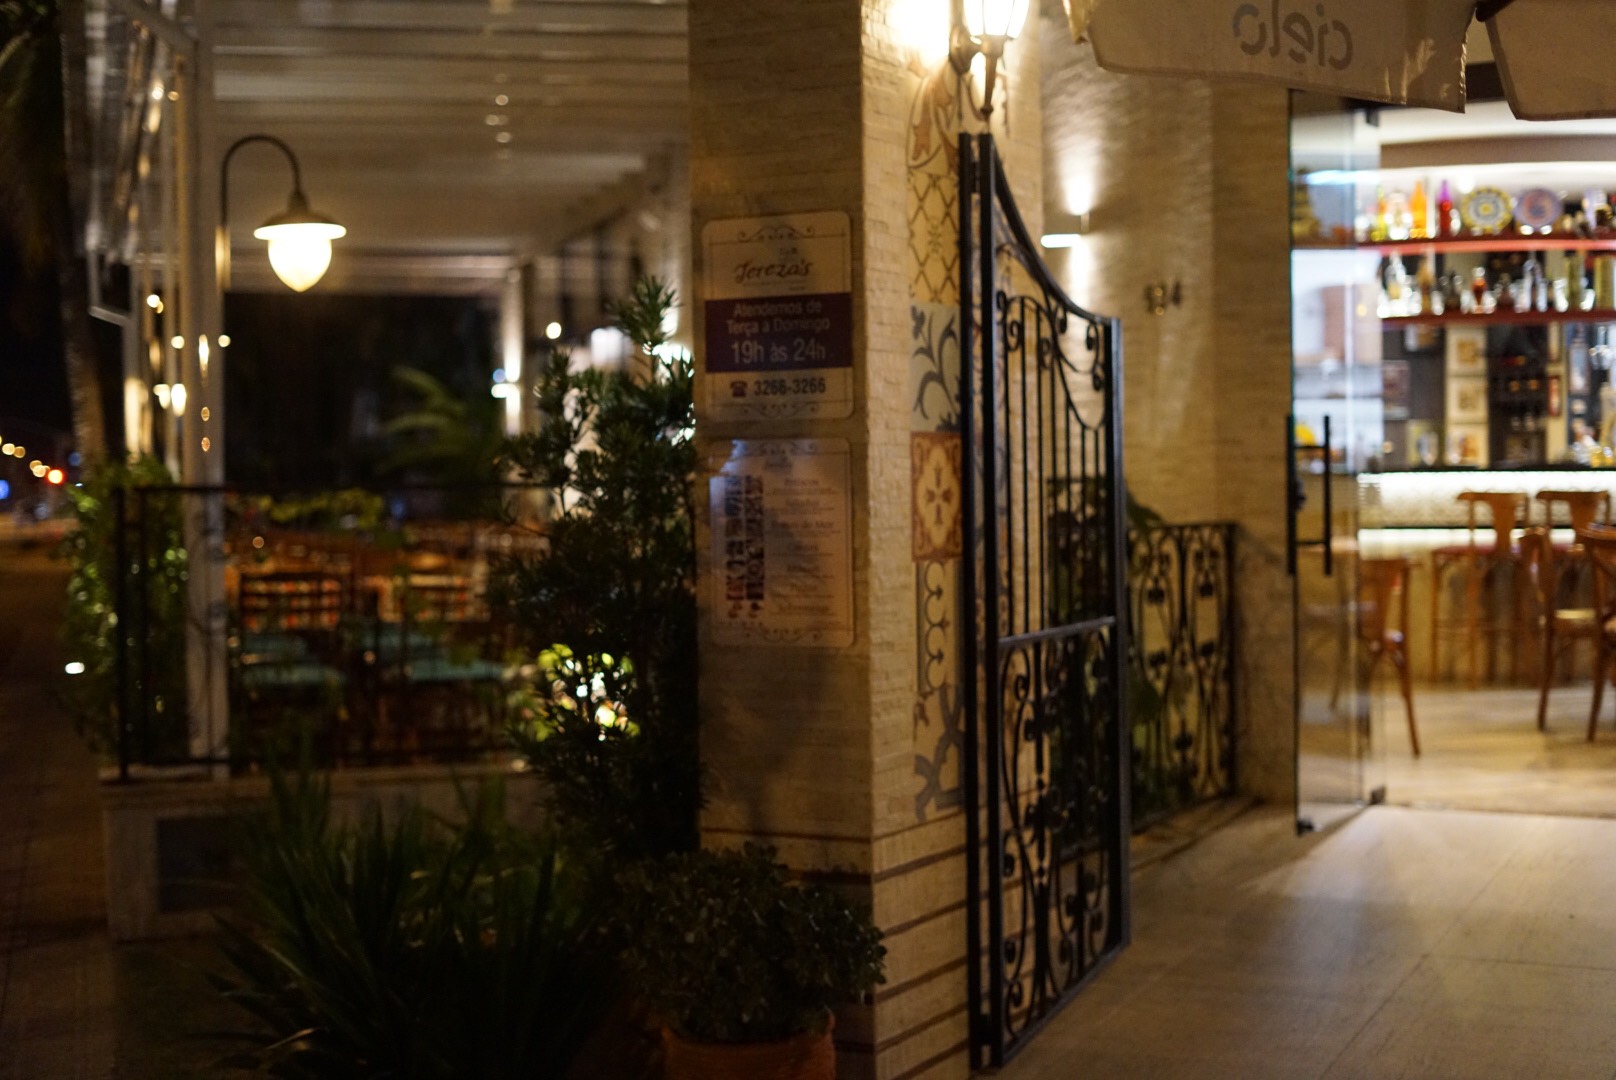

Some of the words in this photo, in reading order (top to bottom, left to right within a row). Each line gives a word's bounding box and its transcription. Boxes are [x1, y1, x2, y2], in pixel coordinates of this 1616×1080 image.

[805, 300, 823, 314] de
[773, 318, 831, 334] Domingo
[731, 339, 765, 365] 19h
[793, 337, 826, 362] 24h
